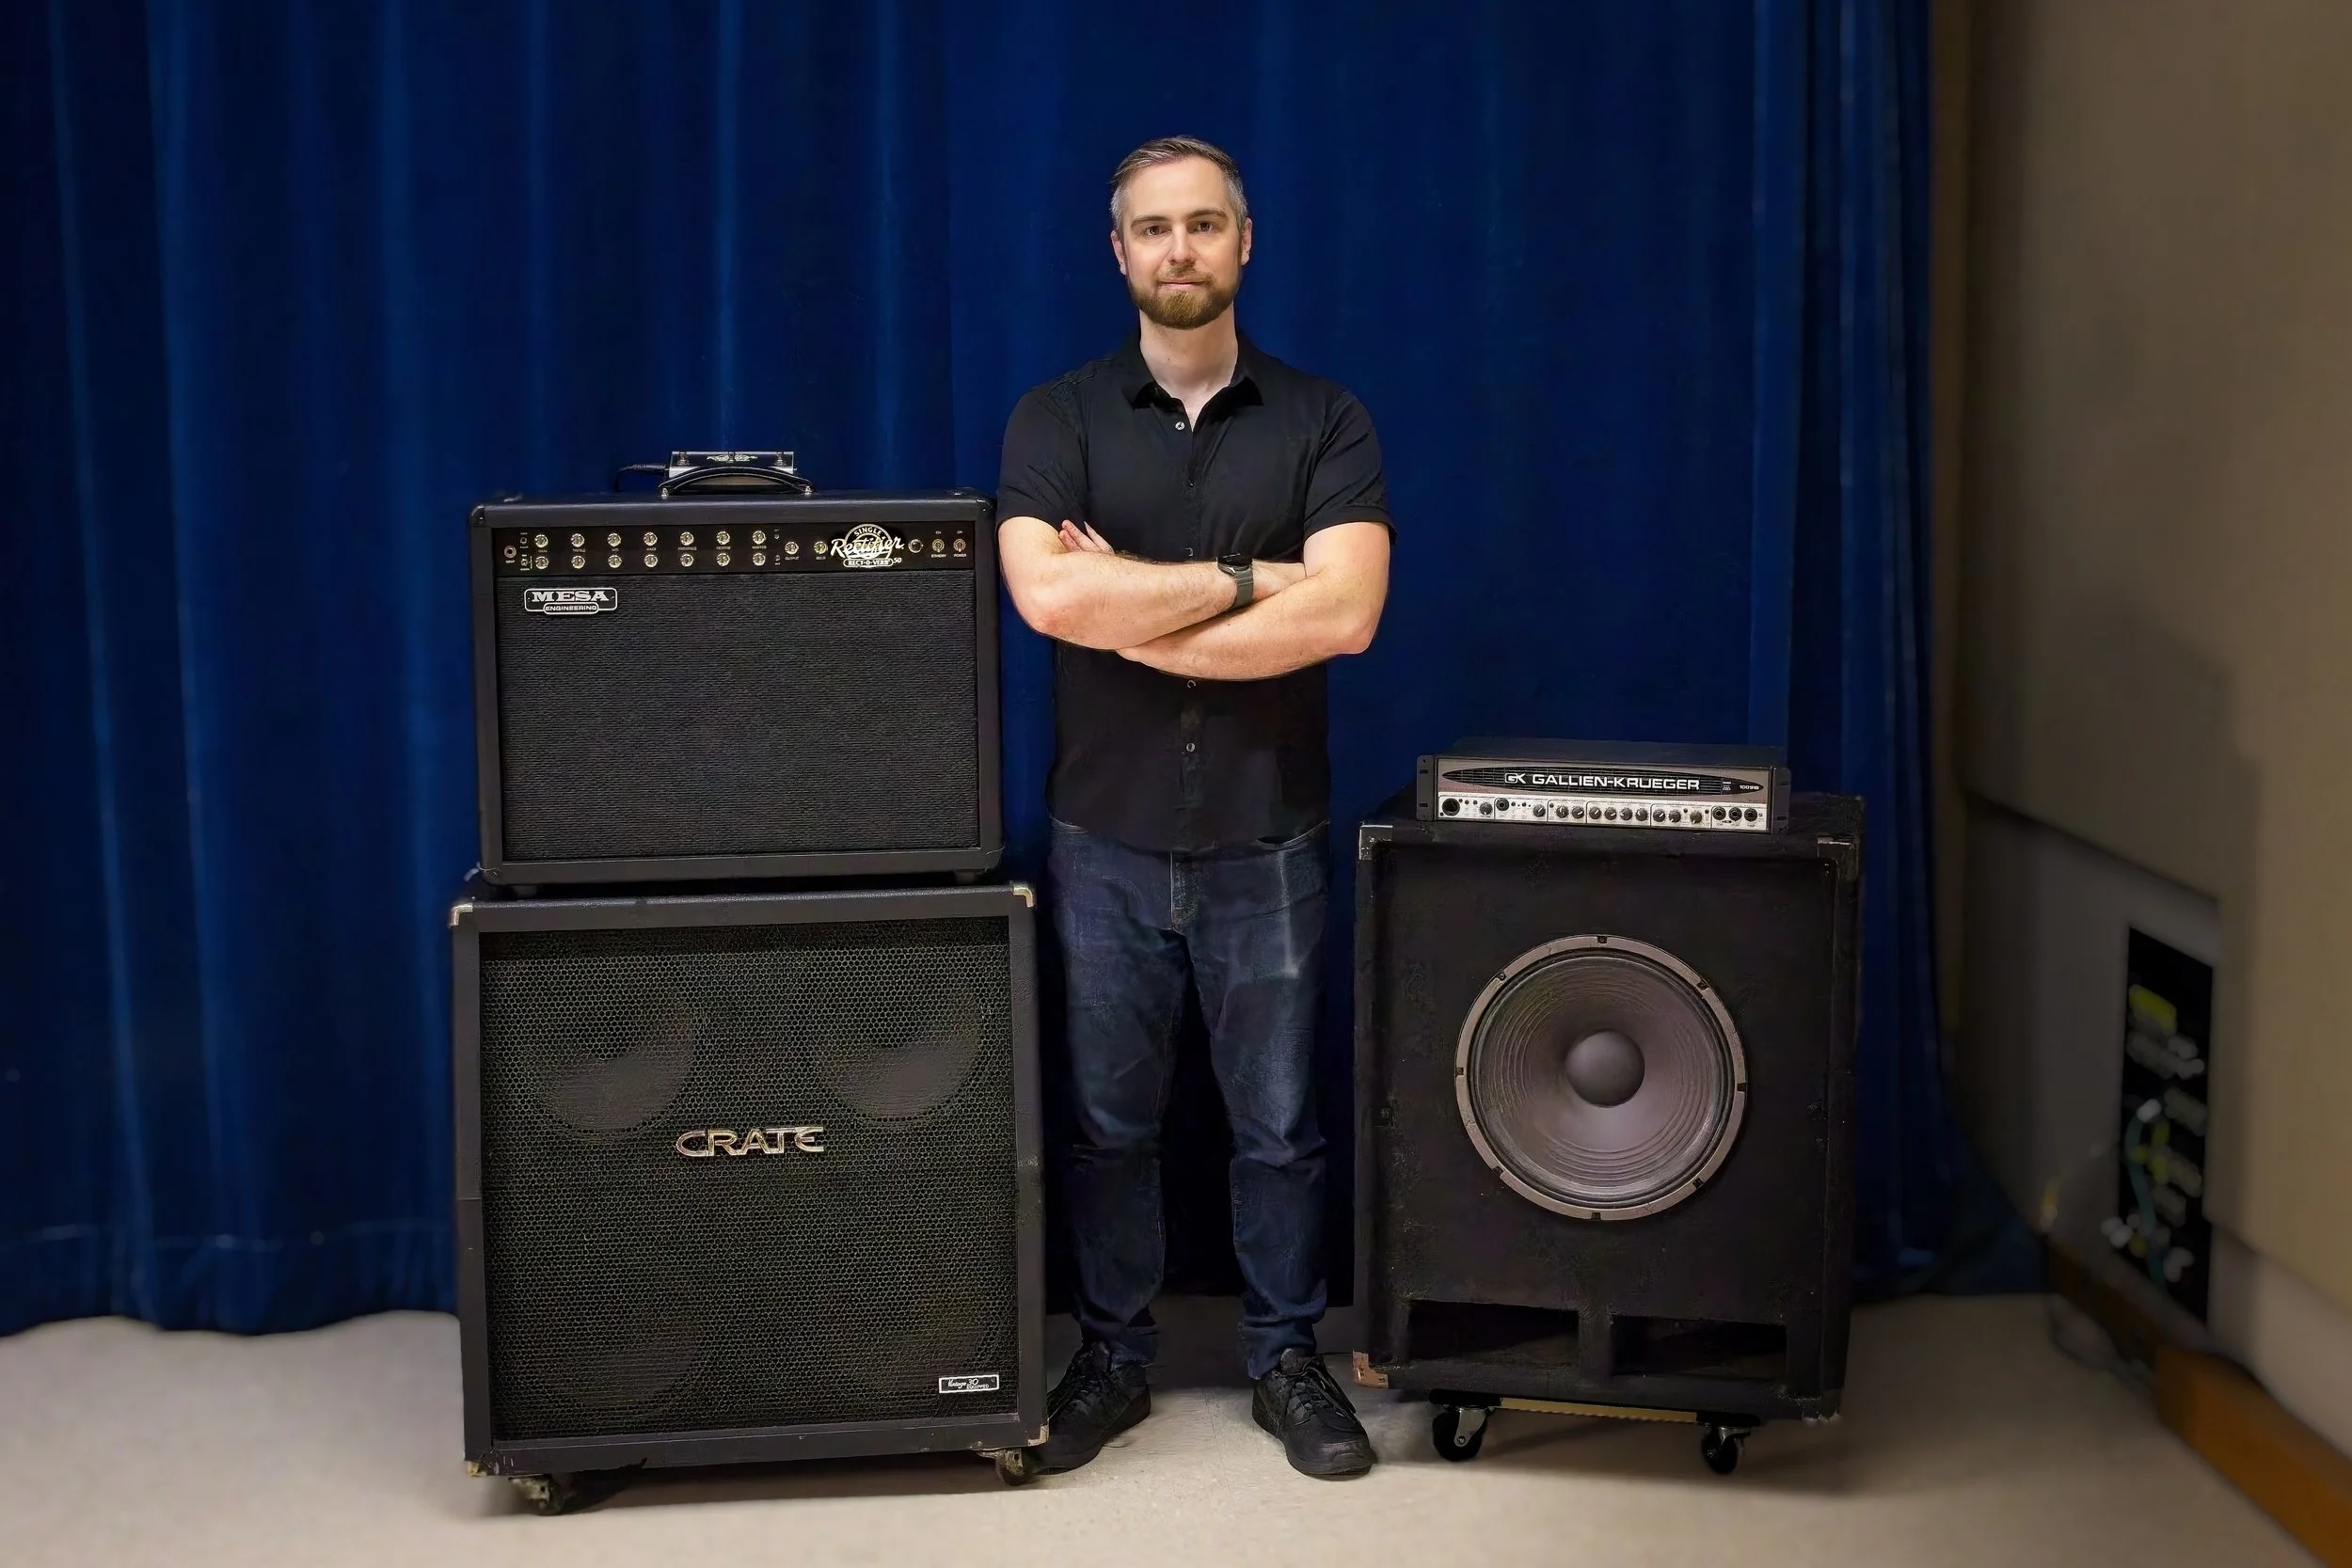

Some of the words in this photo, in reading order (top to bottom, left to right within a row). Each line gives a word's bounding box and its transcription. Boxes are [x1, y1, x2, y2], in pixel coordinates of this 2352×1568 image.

[853, 527, 882, 537] SINGLE
[532, 591, 610, 602] MESA
[1532, 773, 1699, 790] GALLIEN-KRUEGER
[675, 1126, 825, 1158] CRATE
